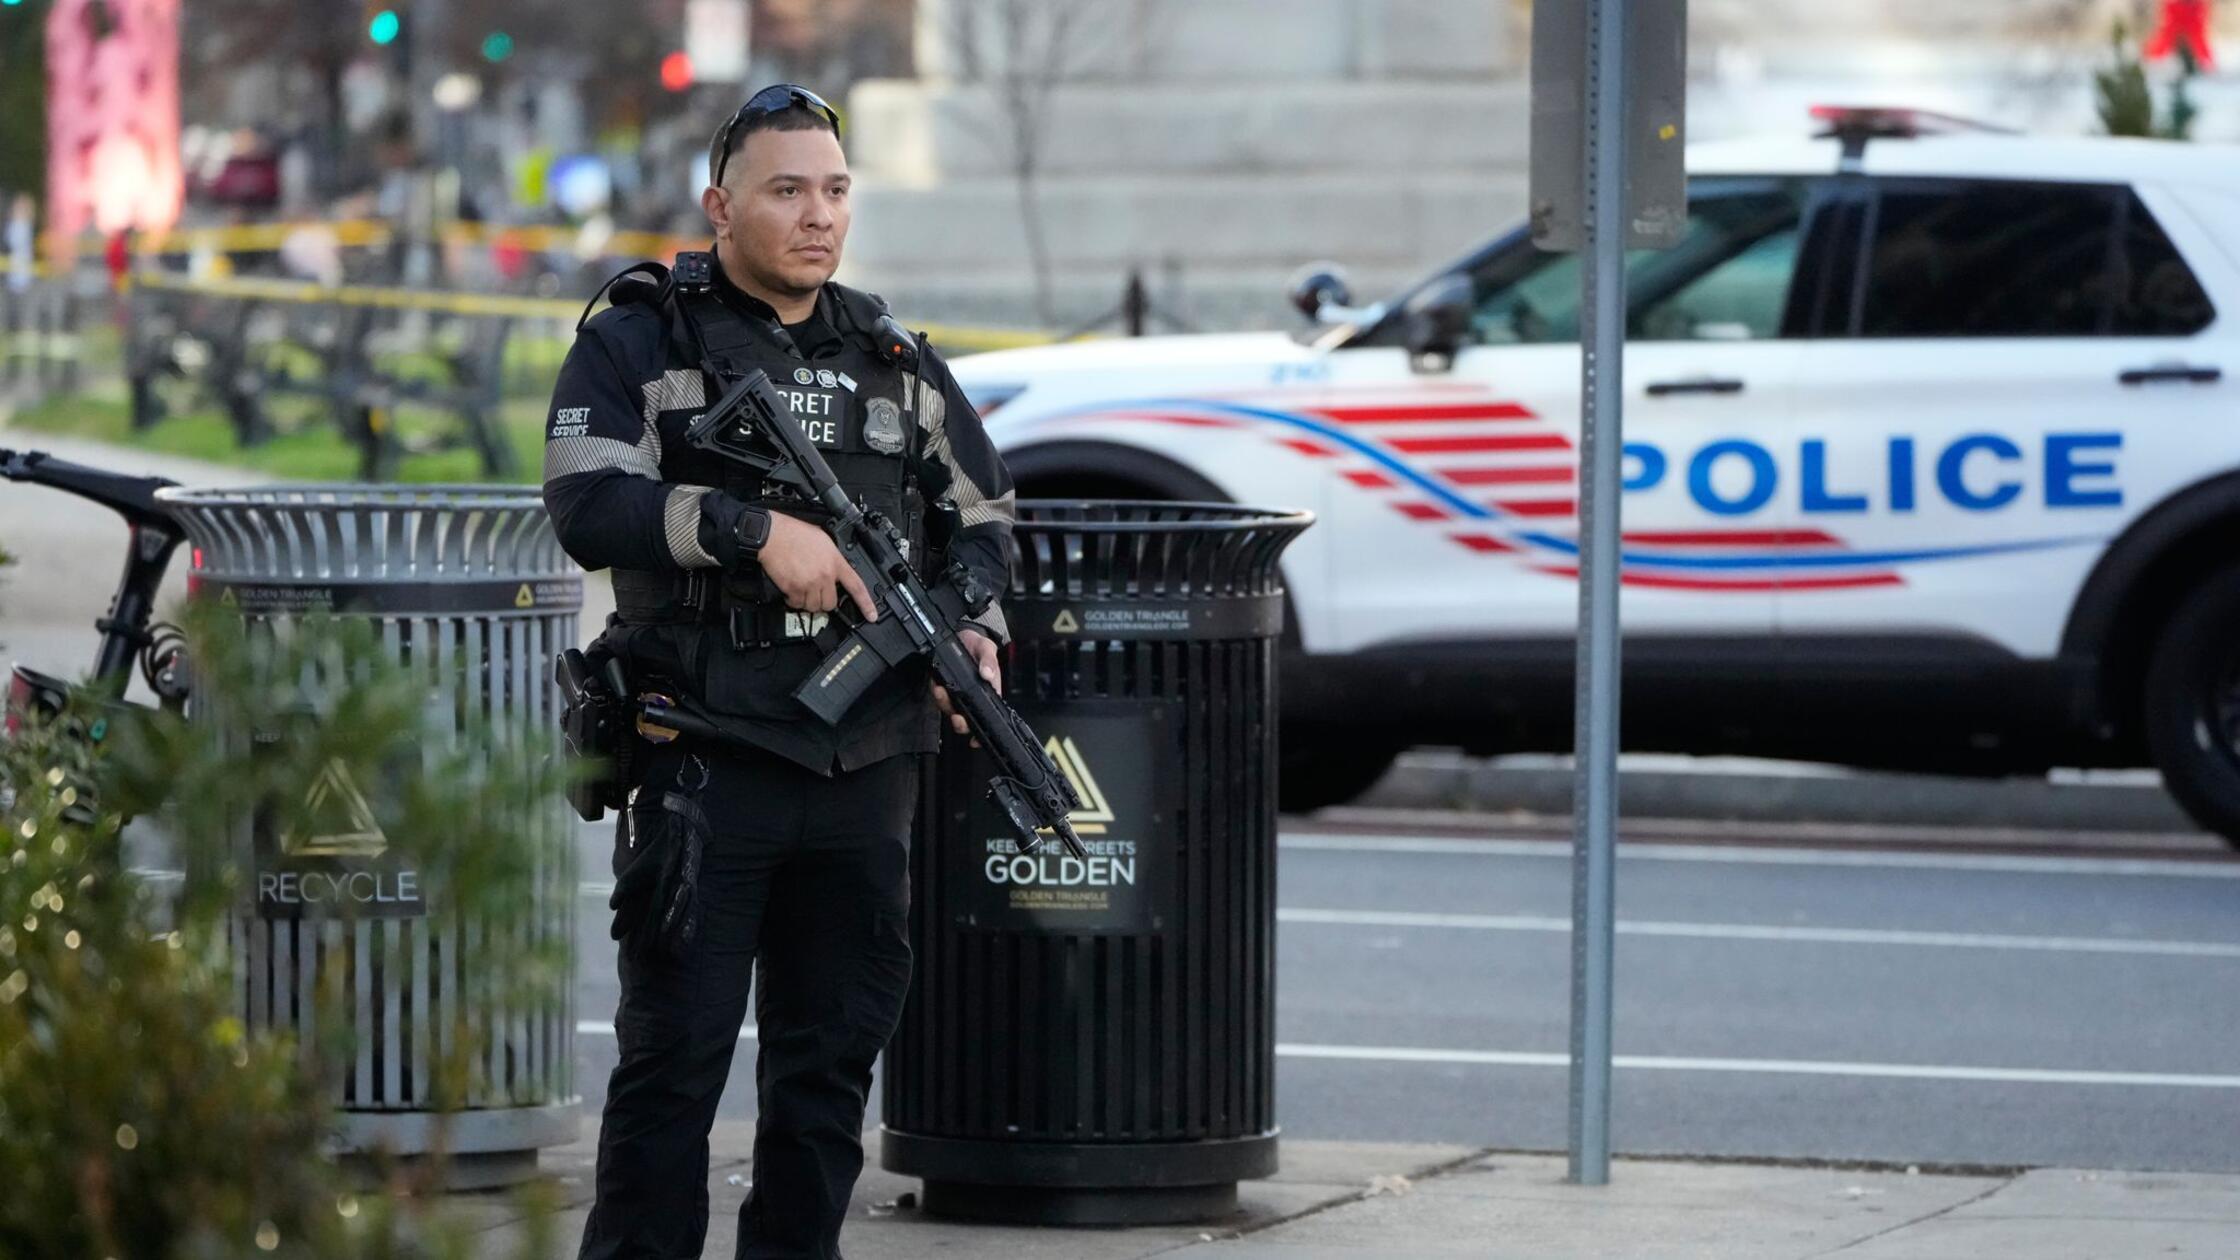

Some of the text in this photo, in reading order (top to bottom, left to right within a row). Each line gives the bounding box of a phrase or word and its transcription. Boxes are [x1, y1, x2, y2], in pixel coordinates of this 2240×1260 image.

[556, 407, 591, 424] SECRET
[551, 424, 589, 437] SERVICE
[1084, 609, 1189, 621] GOLDEN TRIANGLE
[986, 839, 1019, 853] KEE
[985, 854, 1136, 886] GOLDEN
[259, 871, 419, 903] RECYCLE
[1009, 890, 1107, 902] GOLDEN TRIANGLE
